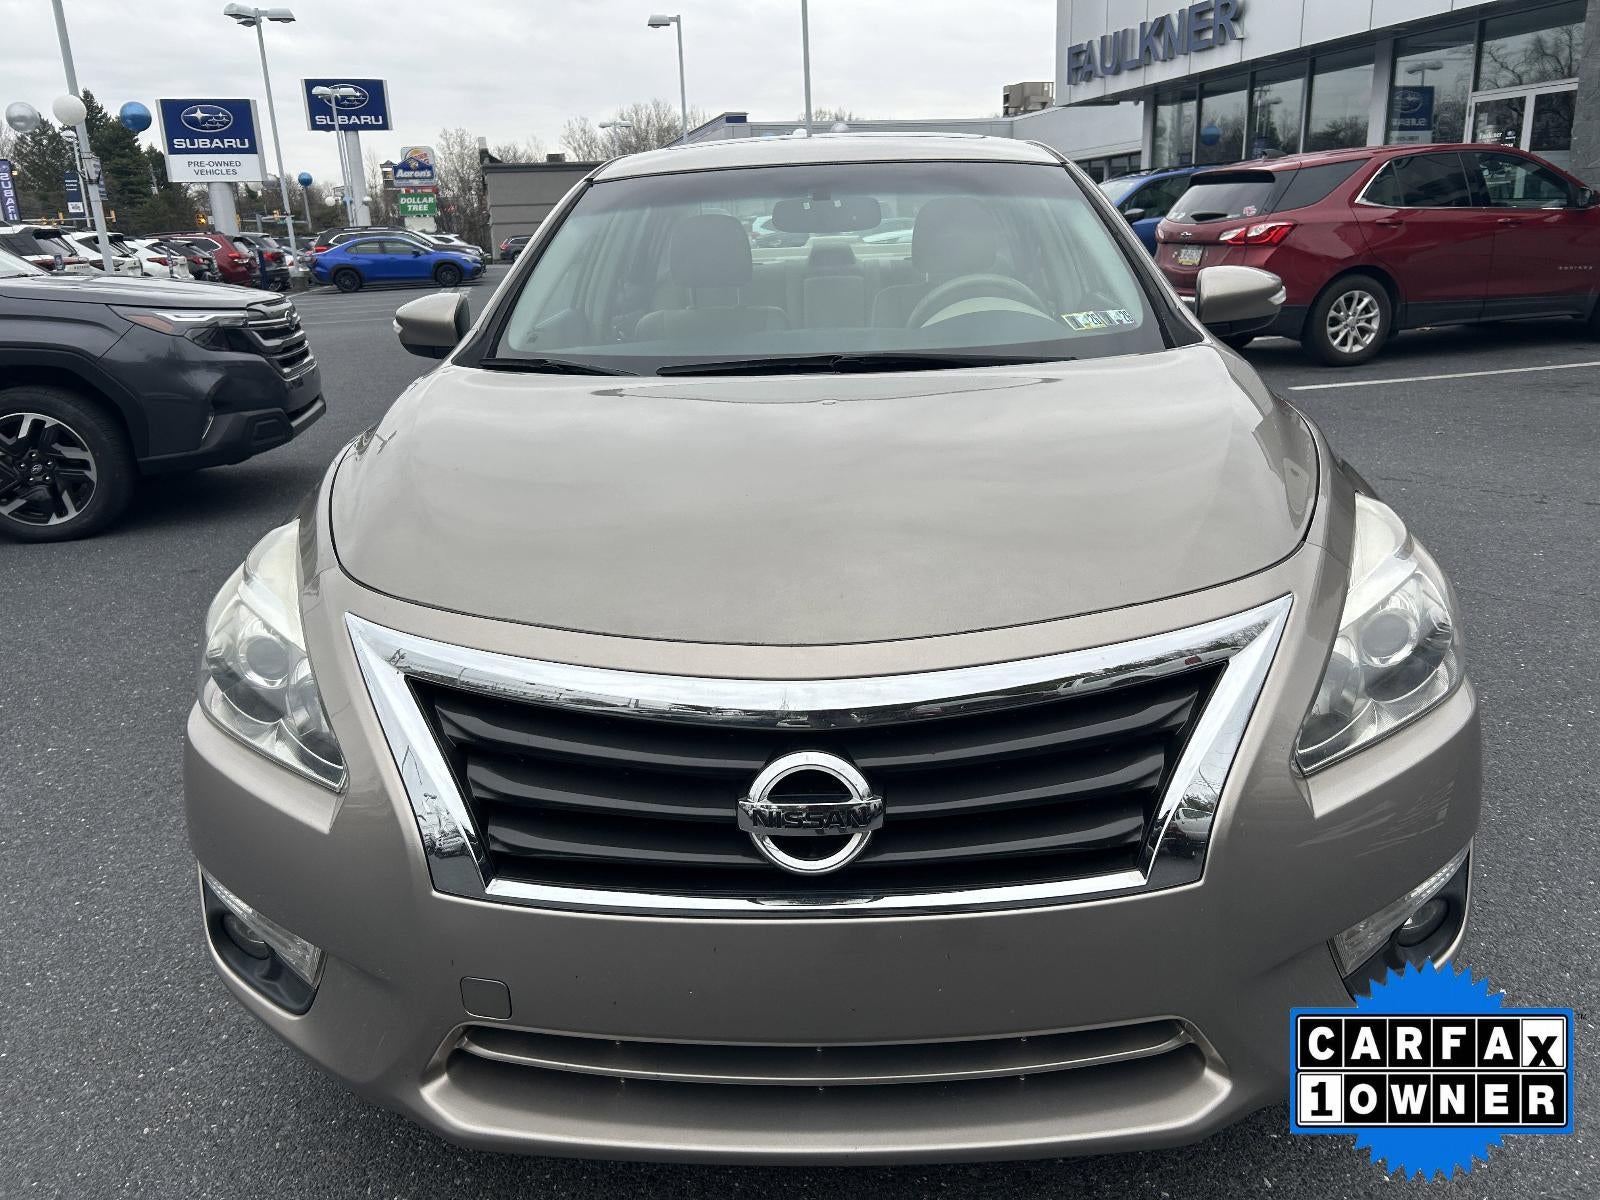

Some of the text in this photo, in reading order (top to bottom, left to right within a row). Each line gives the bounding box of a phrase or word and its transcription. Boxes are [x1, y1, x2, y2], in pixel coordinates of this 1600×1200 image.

[1067, 0, 1244, 85] FAULKNER
[315, 115, 383, 125] SUBARU
[173, 138, 249, 149] SUBARU
[187, 160, 242, 168] PRE-OWNED
[193, 168, 238, 176] VEHICLES
[396, 169, 432, 178] Aaron's
[751, 808, 872, 829] NISSAN
